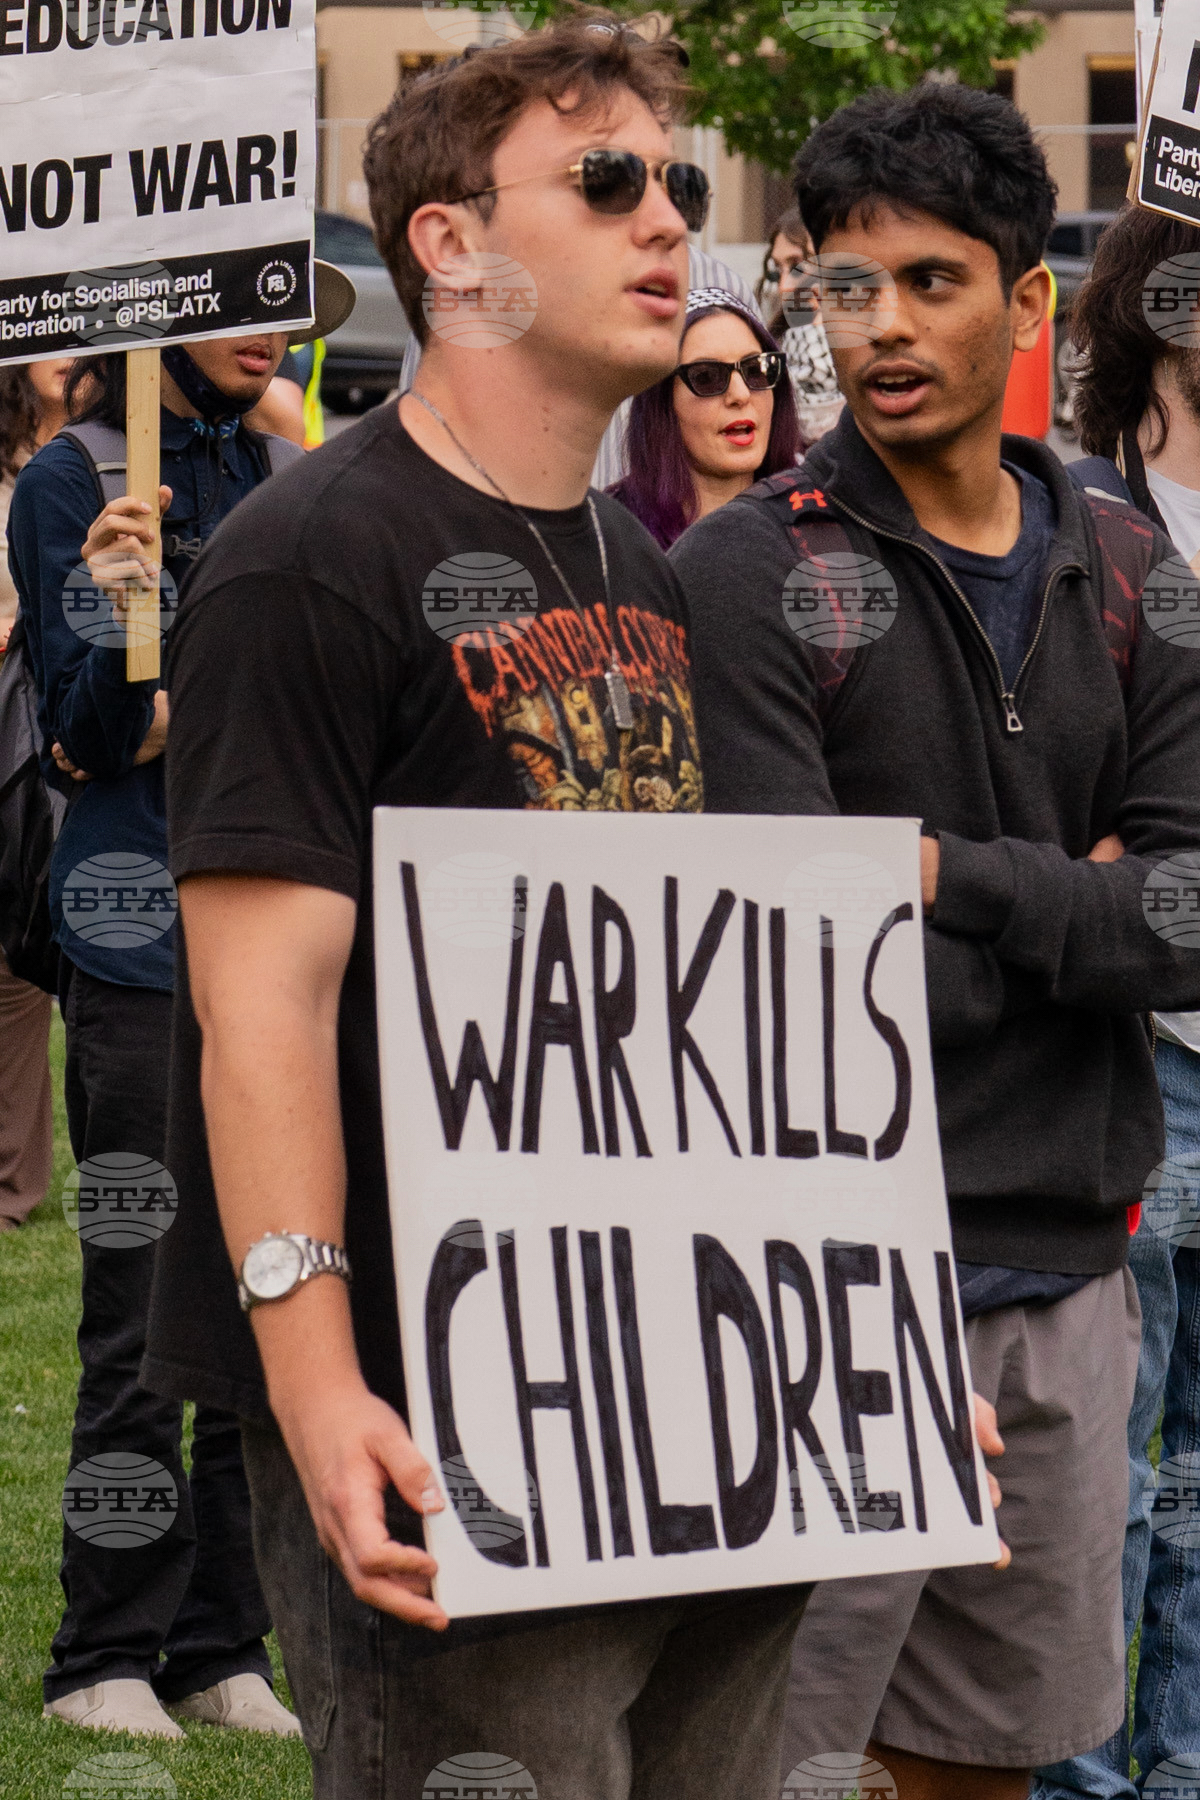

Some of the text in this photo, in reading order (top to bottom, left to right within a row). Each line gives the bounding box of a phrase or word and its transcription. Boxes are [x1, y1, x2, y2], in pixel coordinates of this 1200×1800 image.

[0, 129, 298, 234] NOT WAR!
[0, 268, 213, 317] arty for Socialism and
[0, 292, 222, 341] iberation @PSL.ATX
[399, 860, 915, 1162] WAR KILLS
[424, 1218, 985, 1570] CHILDREN
